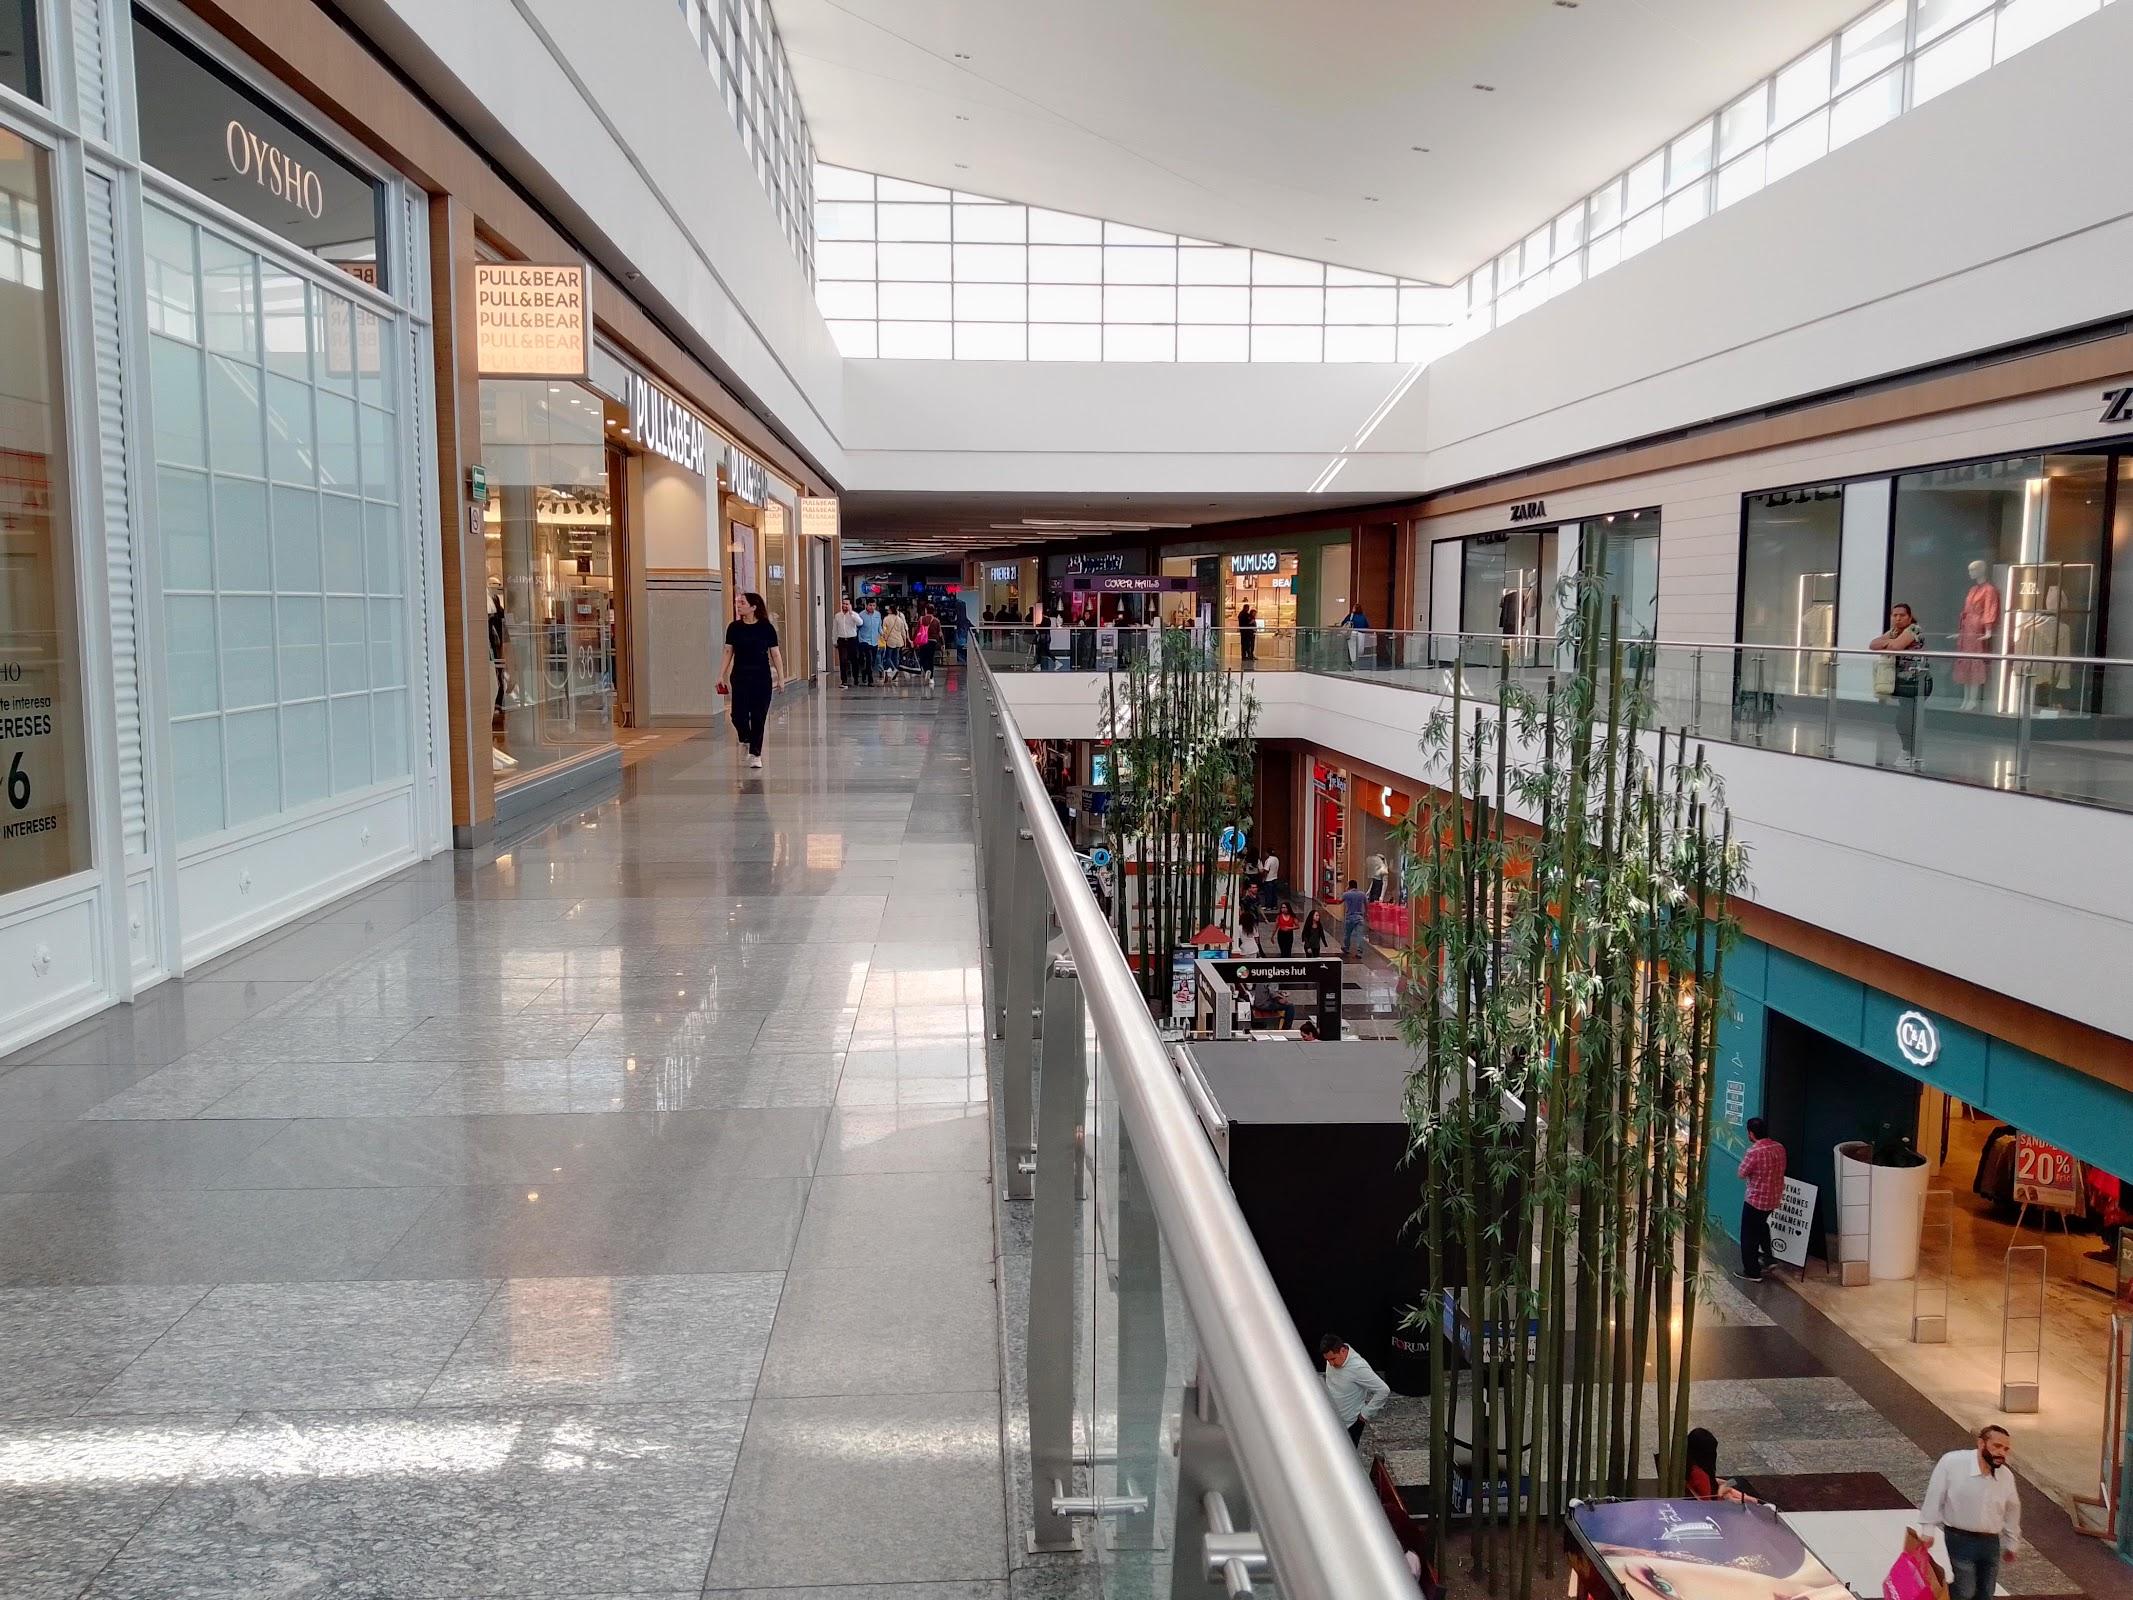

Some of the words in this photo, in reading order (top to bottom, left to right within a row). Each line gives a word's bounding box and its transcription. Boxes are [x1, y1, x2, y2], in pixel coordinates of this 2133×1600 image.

[227, 121, 322, 219] OYSHO
[480, 270, 579, 287] PULL&BEAR
[480, 291, 579, 308] PULL&BEAR
[480, 312, 580, 328] PULL&BEAR
[481, 333, 580, 350] PULL&BEAR
[637, 374, 705, 477] PULL&BEAR
[1510, 501, 1547, 521] ZARA
[1232, 552, 1277, 572] MUMUSO
[1104, 578, 1133, 589] COVER
[1134, 579, 1160, 589] NAILS
[13, 696, 51, 711] interesa
[8, 752, 31, 810] 6
[3, 815, 57, 840] INTERESES
[1251, 967, 1290, 979] sunglass
[1291, 966, 1306, 976] hut
[1902, 1022, 1929, 1054] C&A
[1771, 1220, 1786, 1233] PARA
[1788, 1226, 1795, 1235] TI
[1392, 1336, 1429, 1353] FORUM
